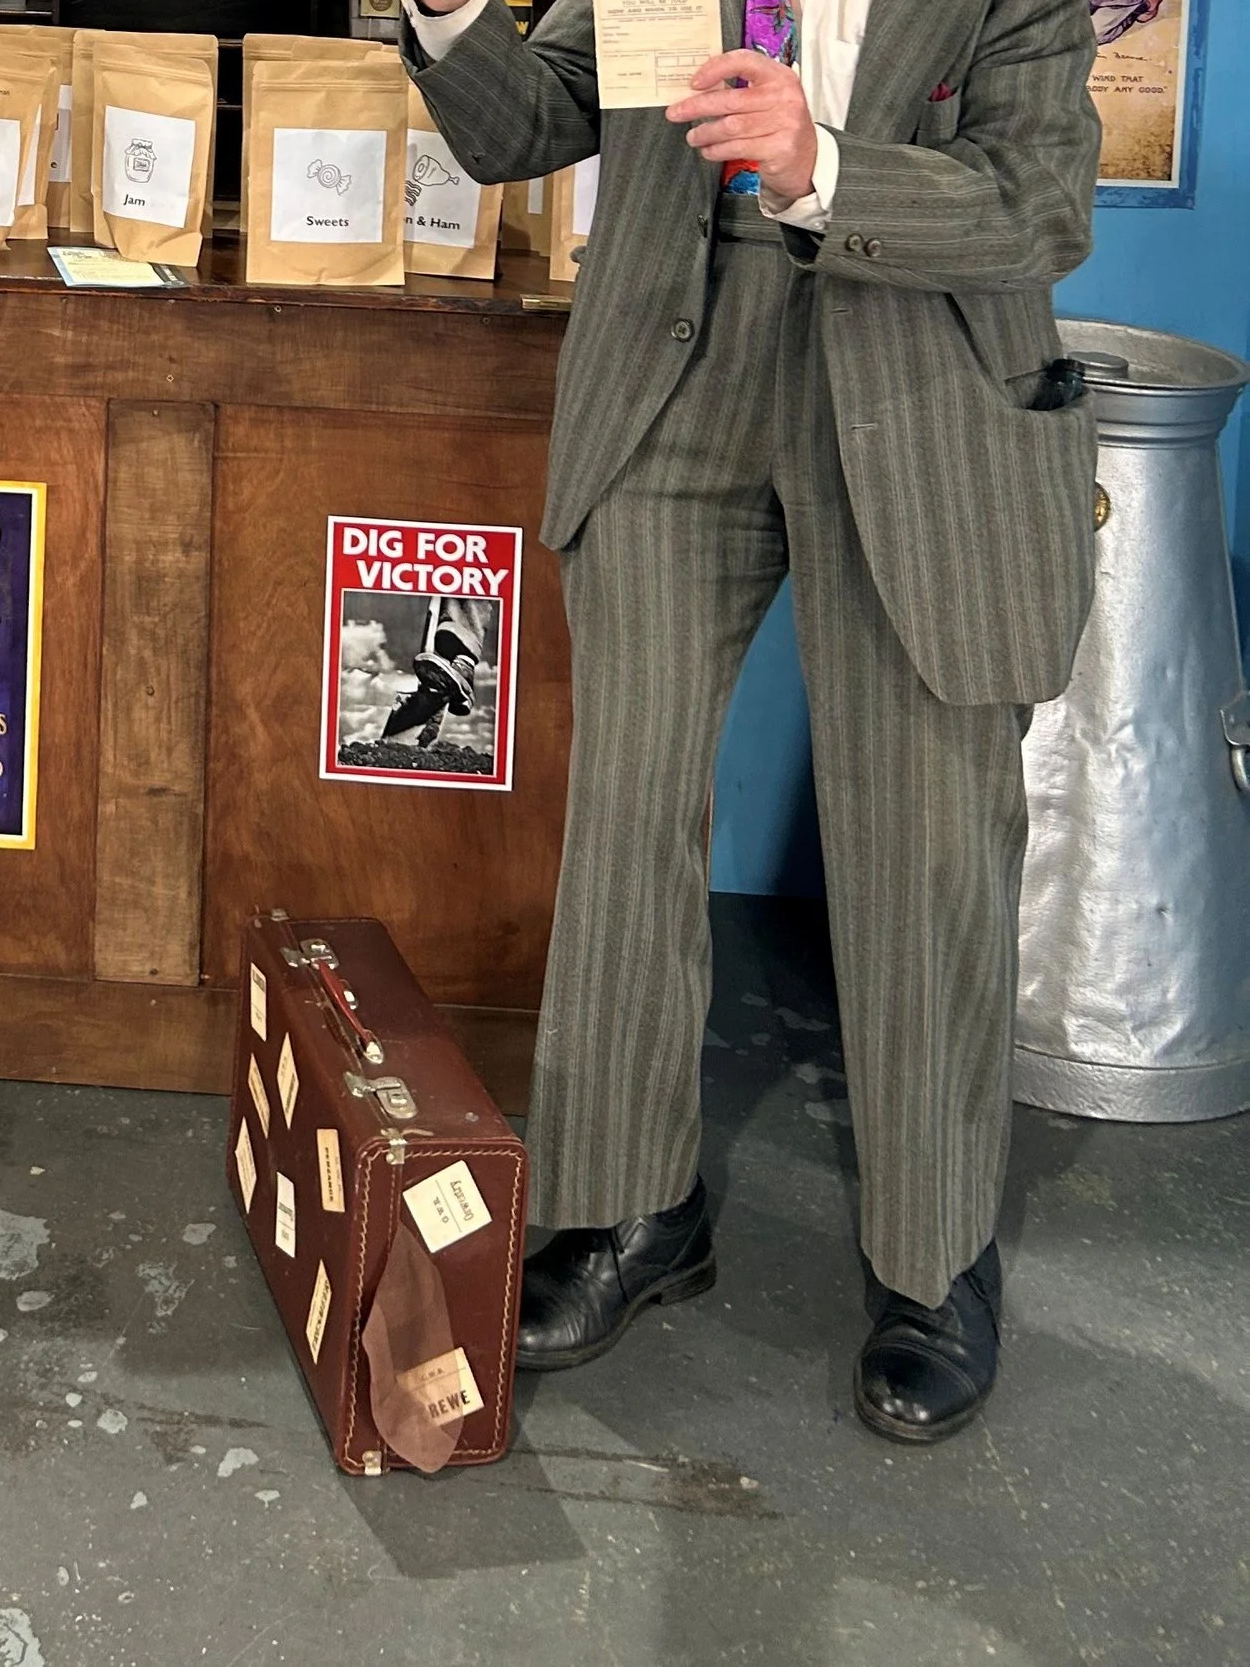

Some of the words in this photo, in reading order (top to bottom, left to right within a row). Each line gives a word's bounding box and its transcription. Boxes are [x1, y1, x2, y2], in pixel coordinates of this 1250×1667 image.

[123, 194, 146, 207] Jam
[306, 215, 350, 228] Sweets
[417, 216, 427, 227] &
[431, 219, 460, 231] Ham
[342, 527, 403, 558] DIG
[417, 532, 488, 563] FOR
[356, 560, 509, 596] VICTORY
[428, 1390, 470, 1418] REWE
